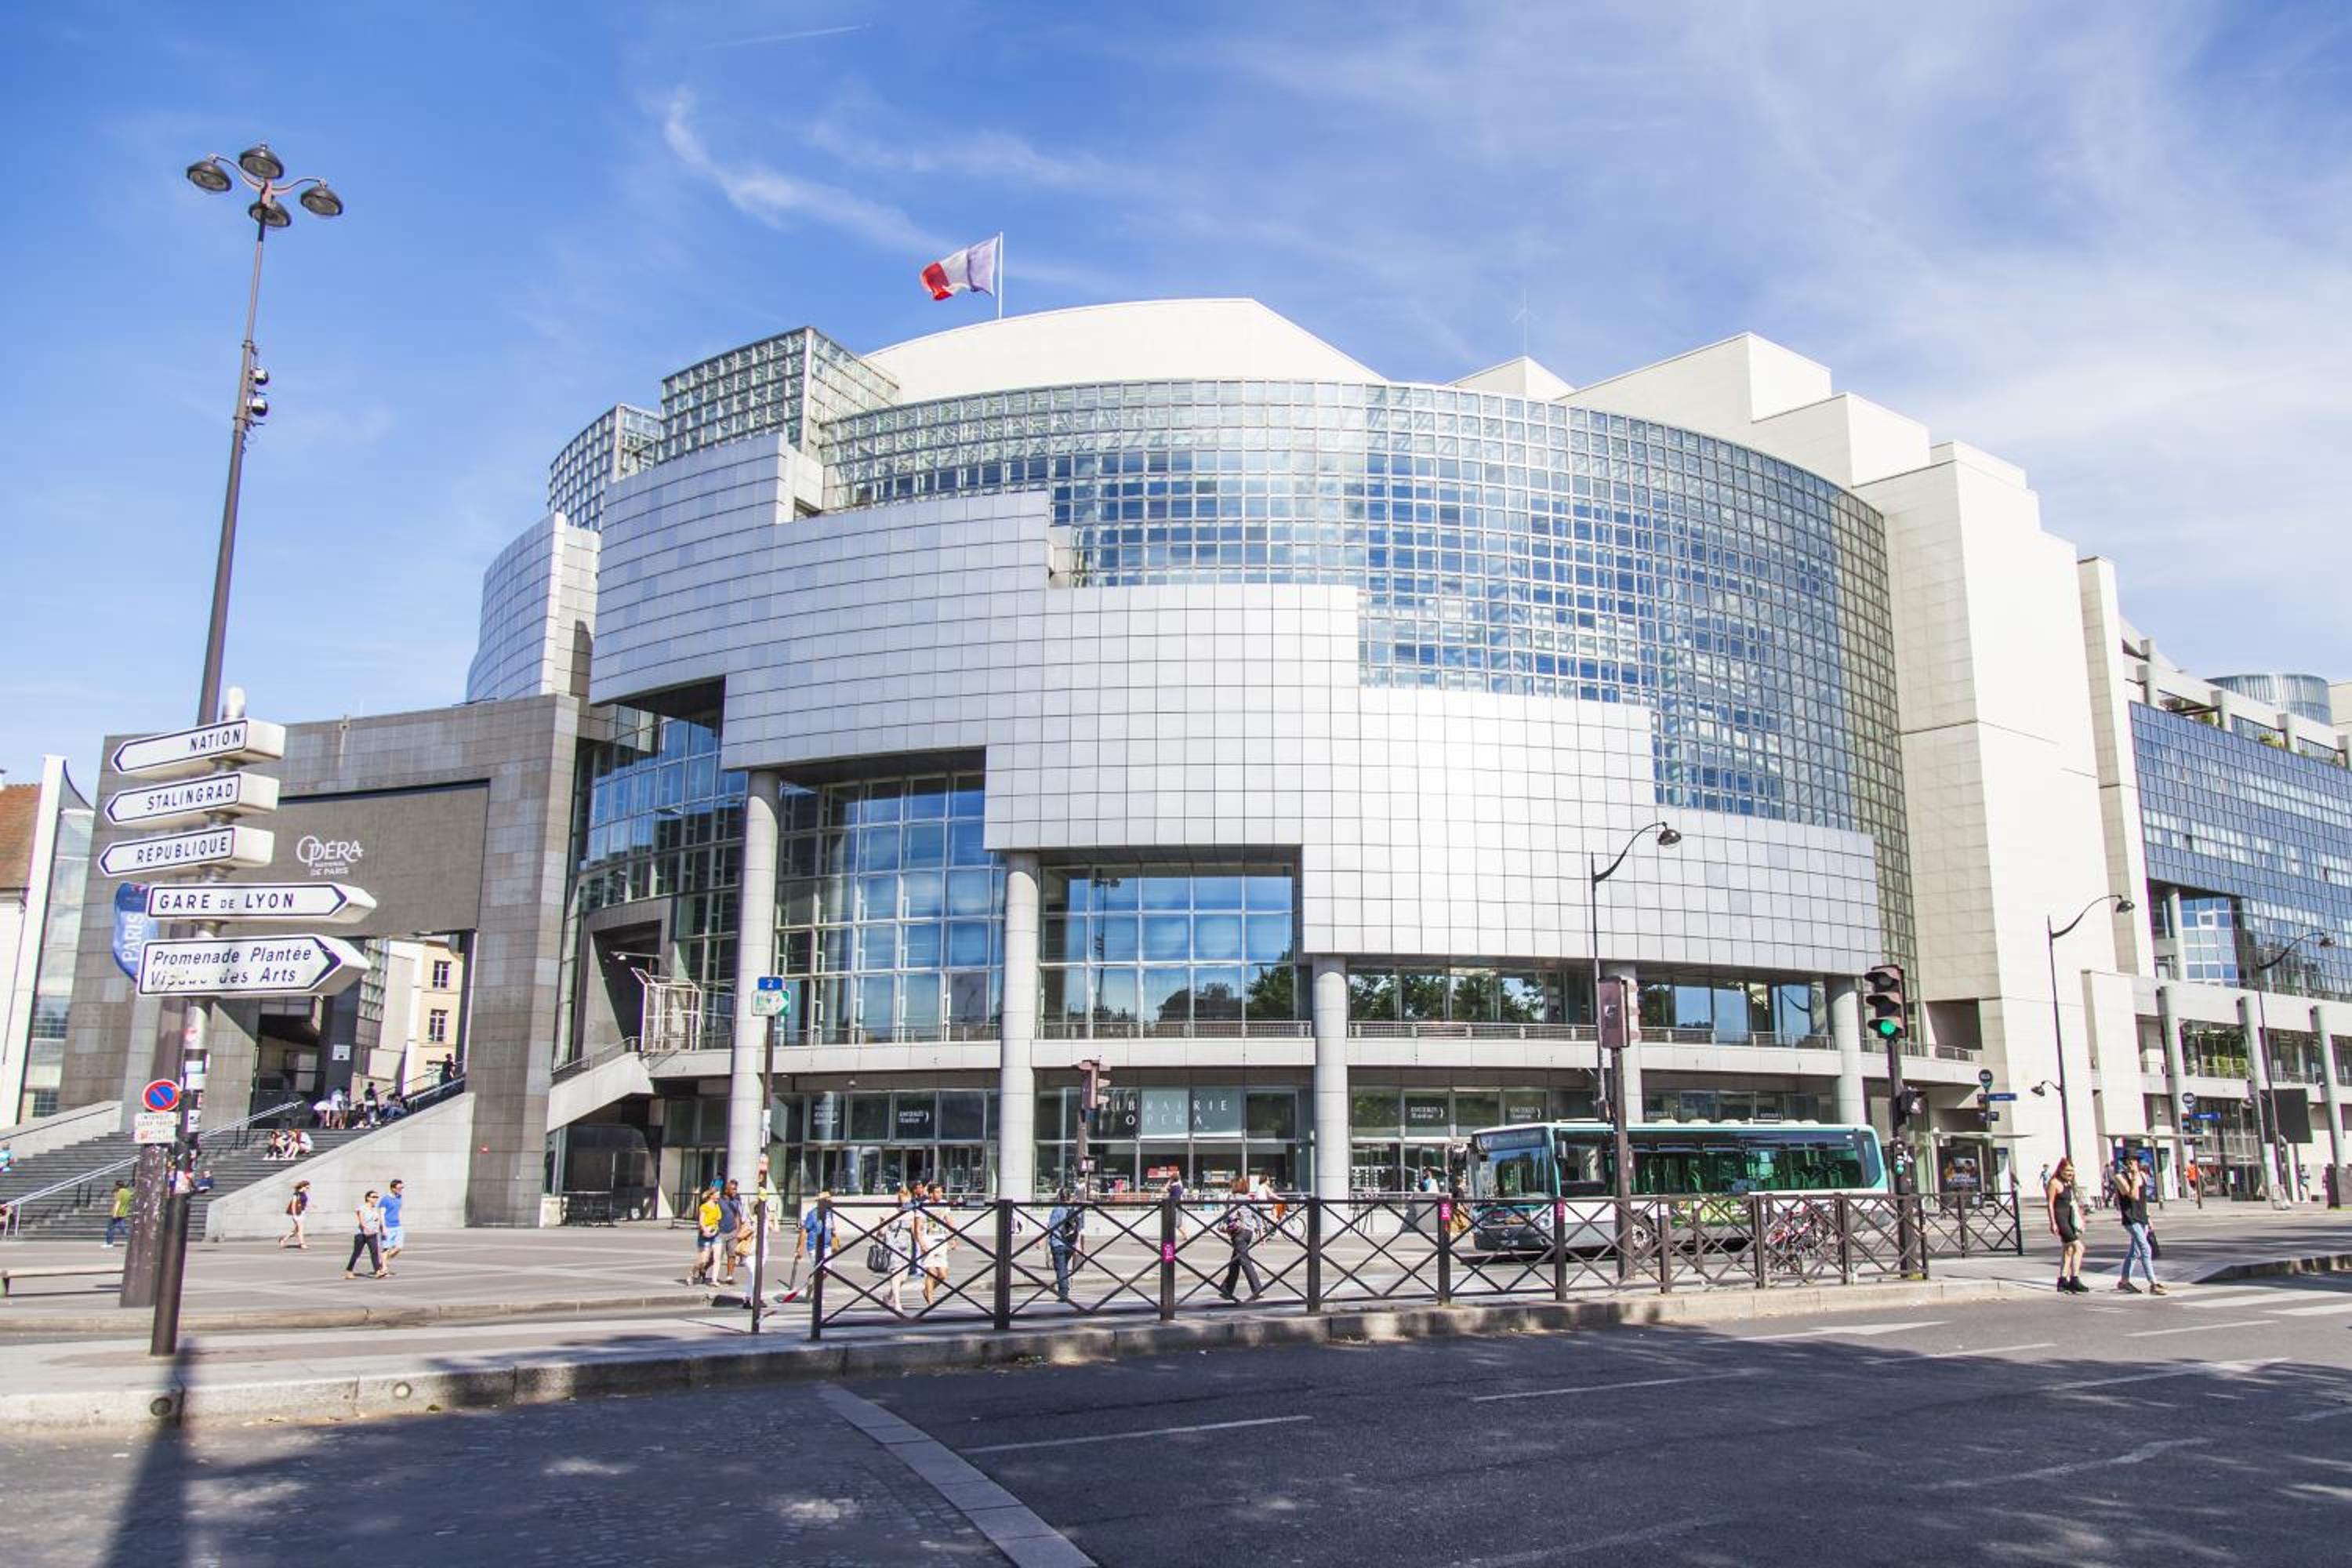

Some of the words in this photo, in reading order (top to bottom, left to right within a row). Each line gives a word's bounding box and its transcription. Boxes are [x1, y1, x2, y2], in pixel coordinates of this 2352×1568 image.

[191, 728, 241, 751] NATION
[147, 782, 233, 811] STALINGRAD
[136, 836, 227, 863] RÉPUBLIQUE
[159, 894, 210, 909] GARE
[220, 899, 235, 908] DE
[245, 893, 295, 908] LYON
[122, 913, 147, 962] PARIS
[153, 947, 239, 965] Promenade
[250, 946, 311, 962] Plantée
[260, 967, 296, 982] Arts
[1102, 1100, 1227, 1111] LIBRAIRIE
